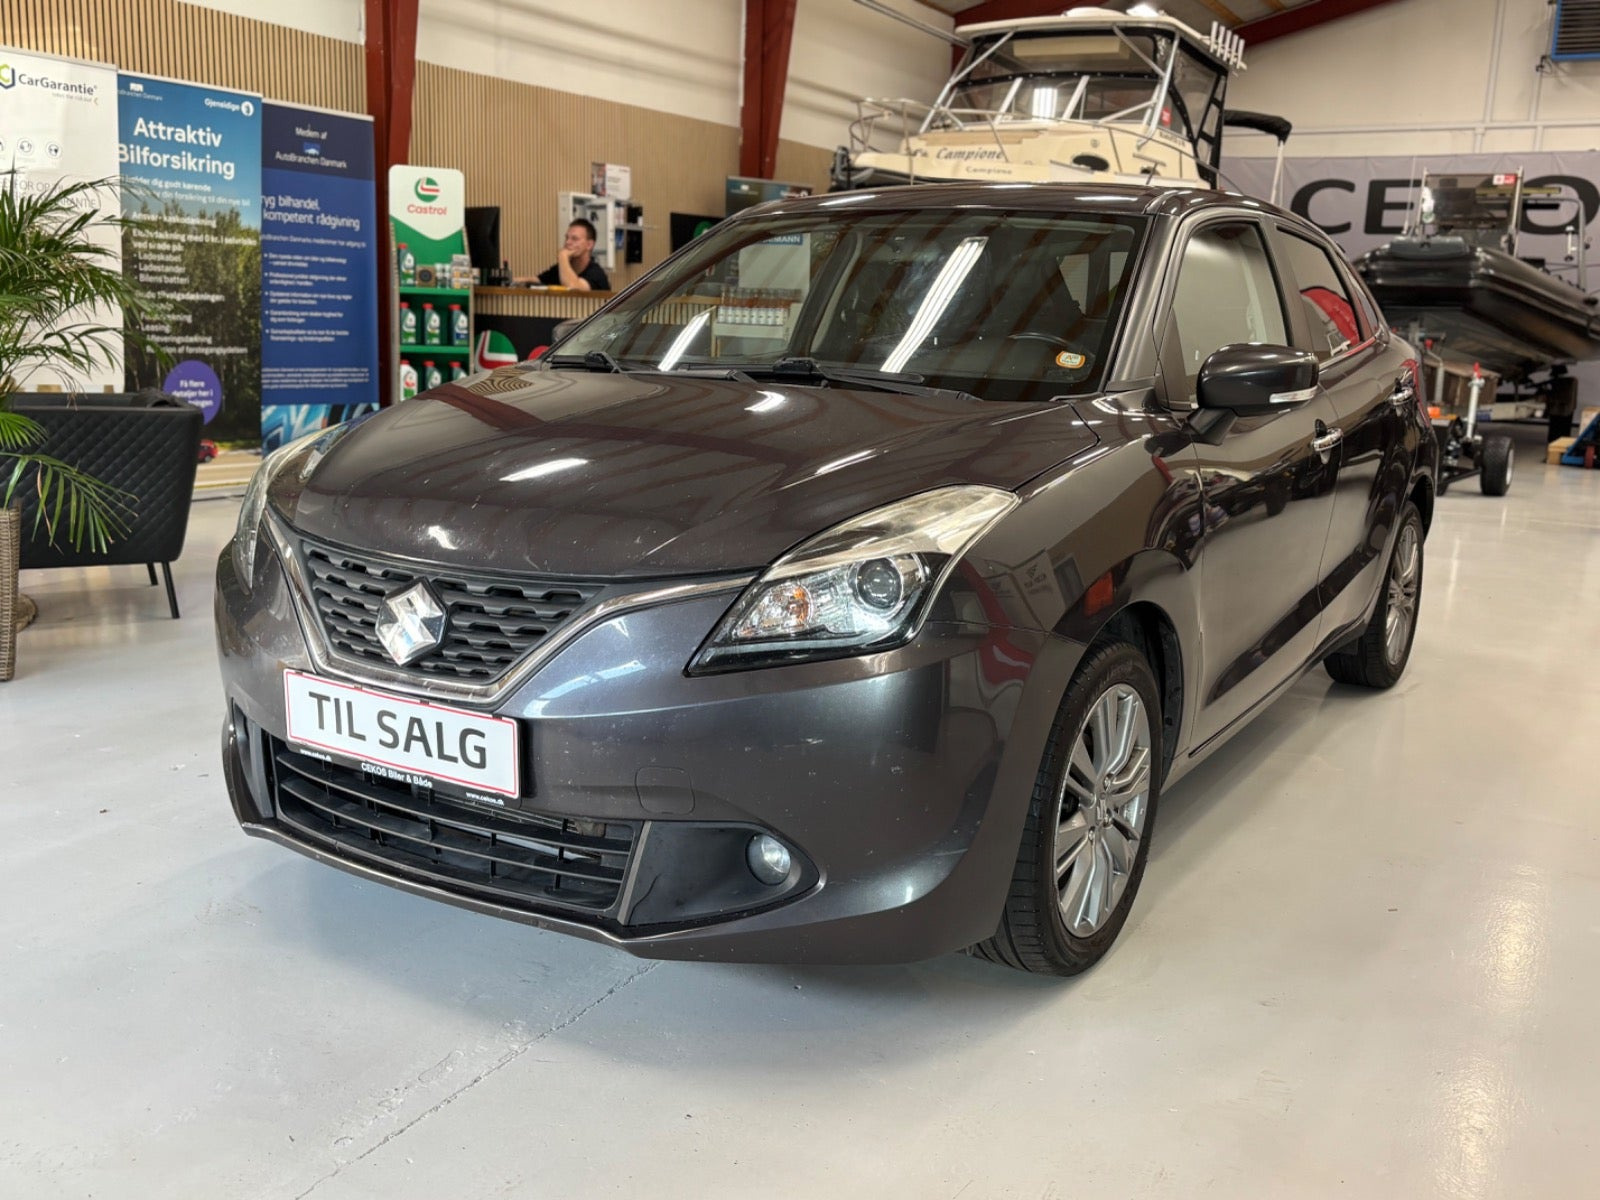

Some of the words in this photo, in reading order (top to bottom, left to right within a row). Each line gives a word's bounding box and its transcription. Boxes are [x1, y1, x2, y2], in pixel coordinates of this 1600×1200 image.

[204, 97, 240, 112] Gjensidige
[133, 116, 222, 148] Attraktiv
[118, 142, 235, 181] Bilforsikring
[407, 203, 447, 216] Castrol
[308, 691, 366, 742] TIL
[376, 709, 487, 770] SALG
